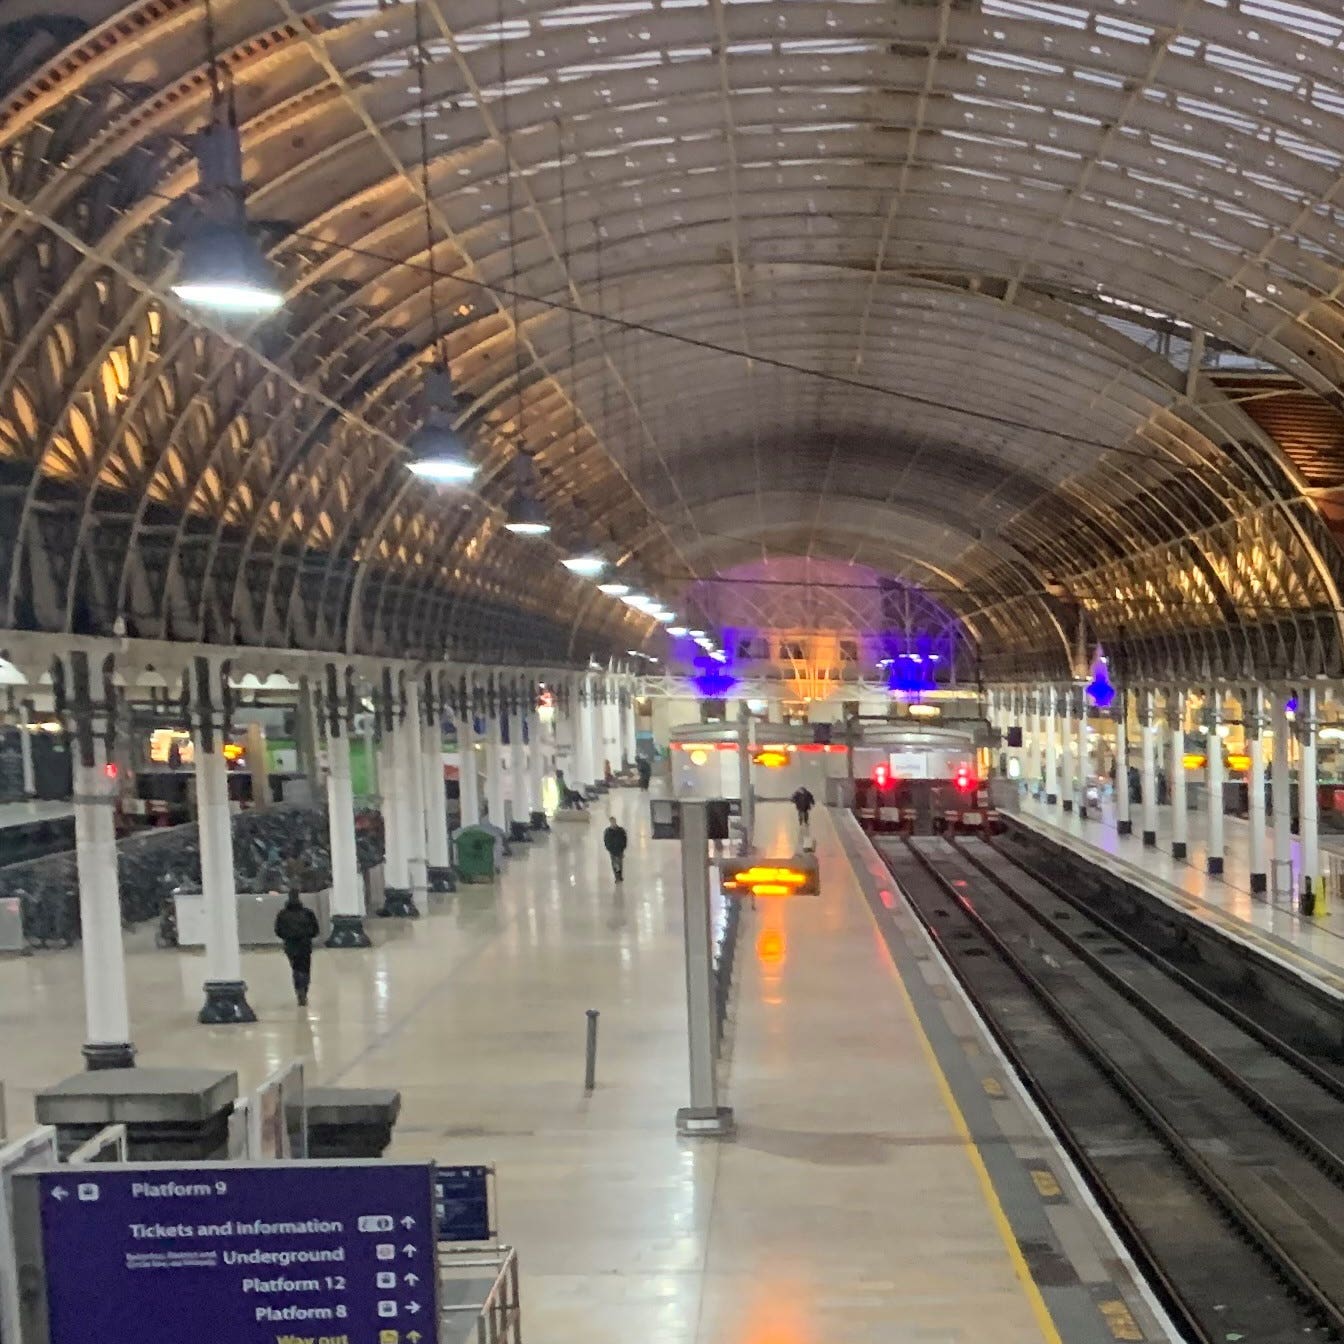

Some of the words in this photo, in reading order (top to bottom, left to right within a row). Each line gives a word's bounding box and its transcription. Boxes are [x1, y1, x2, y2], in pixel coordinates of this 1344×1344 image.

[131, 1182, 212, 1198] Platform
[214, 1181, 228, 1196] 9
[129, 1223, 193, 1239] Tickets
[197, 1221, 233, 1237] and
[236, 1218, 344, 1235] information
[223, 1247, 345, 1266] Underground
[242, 1276, 320, 1293] Platform
[325, 1276, 346, 1290] 12
[254, 1305, 332, 1321] Platform
[335, 1304, 347, 1318] 8
